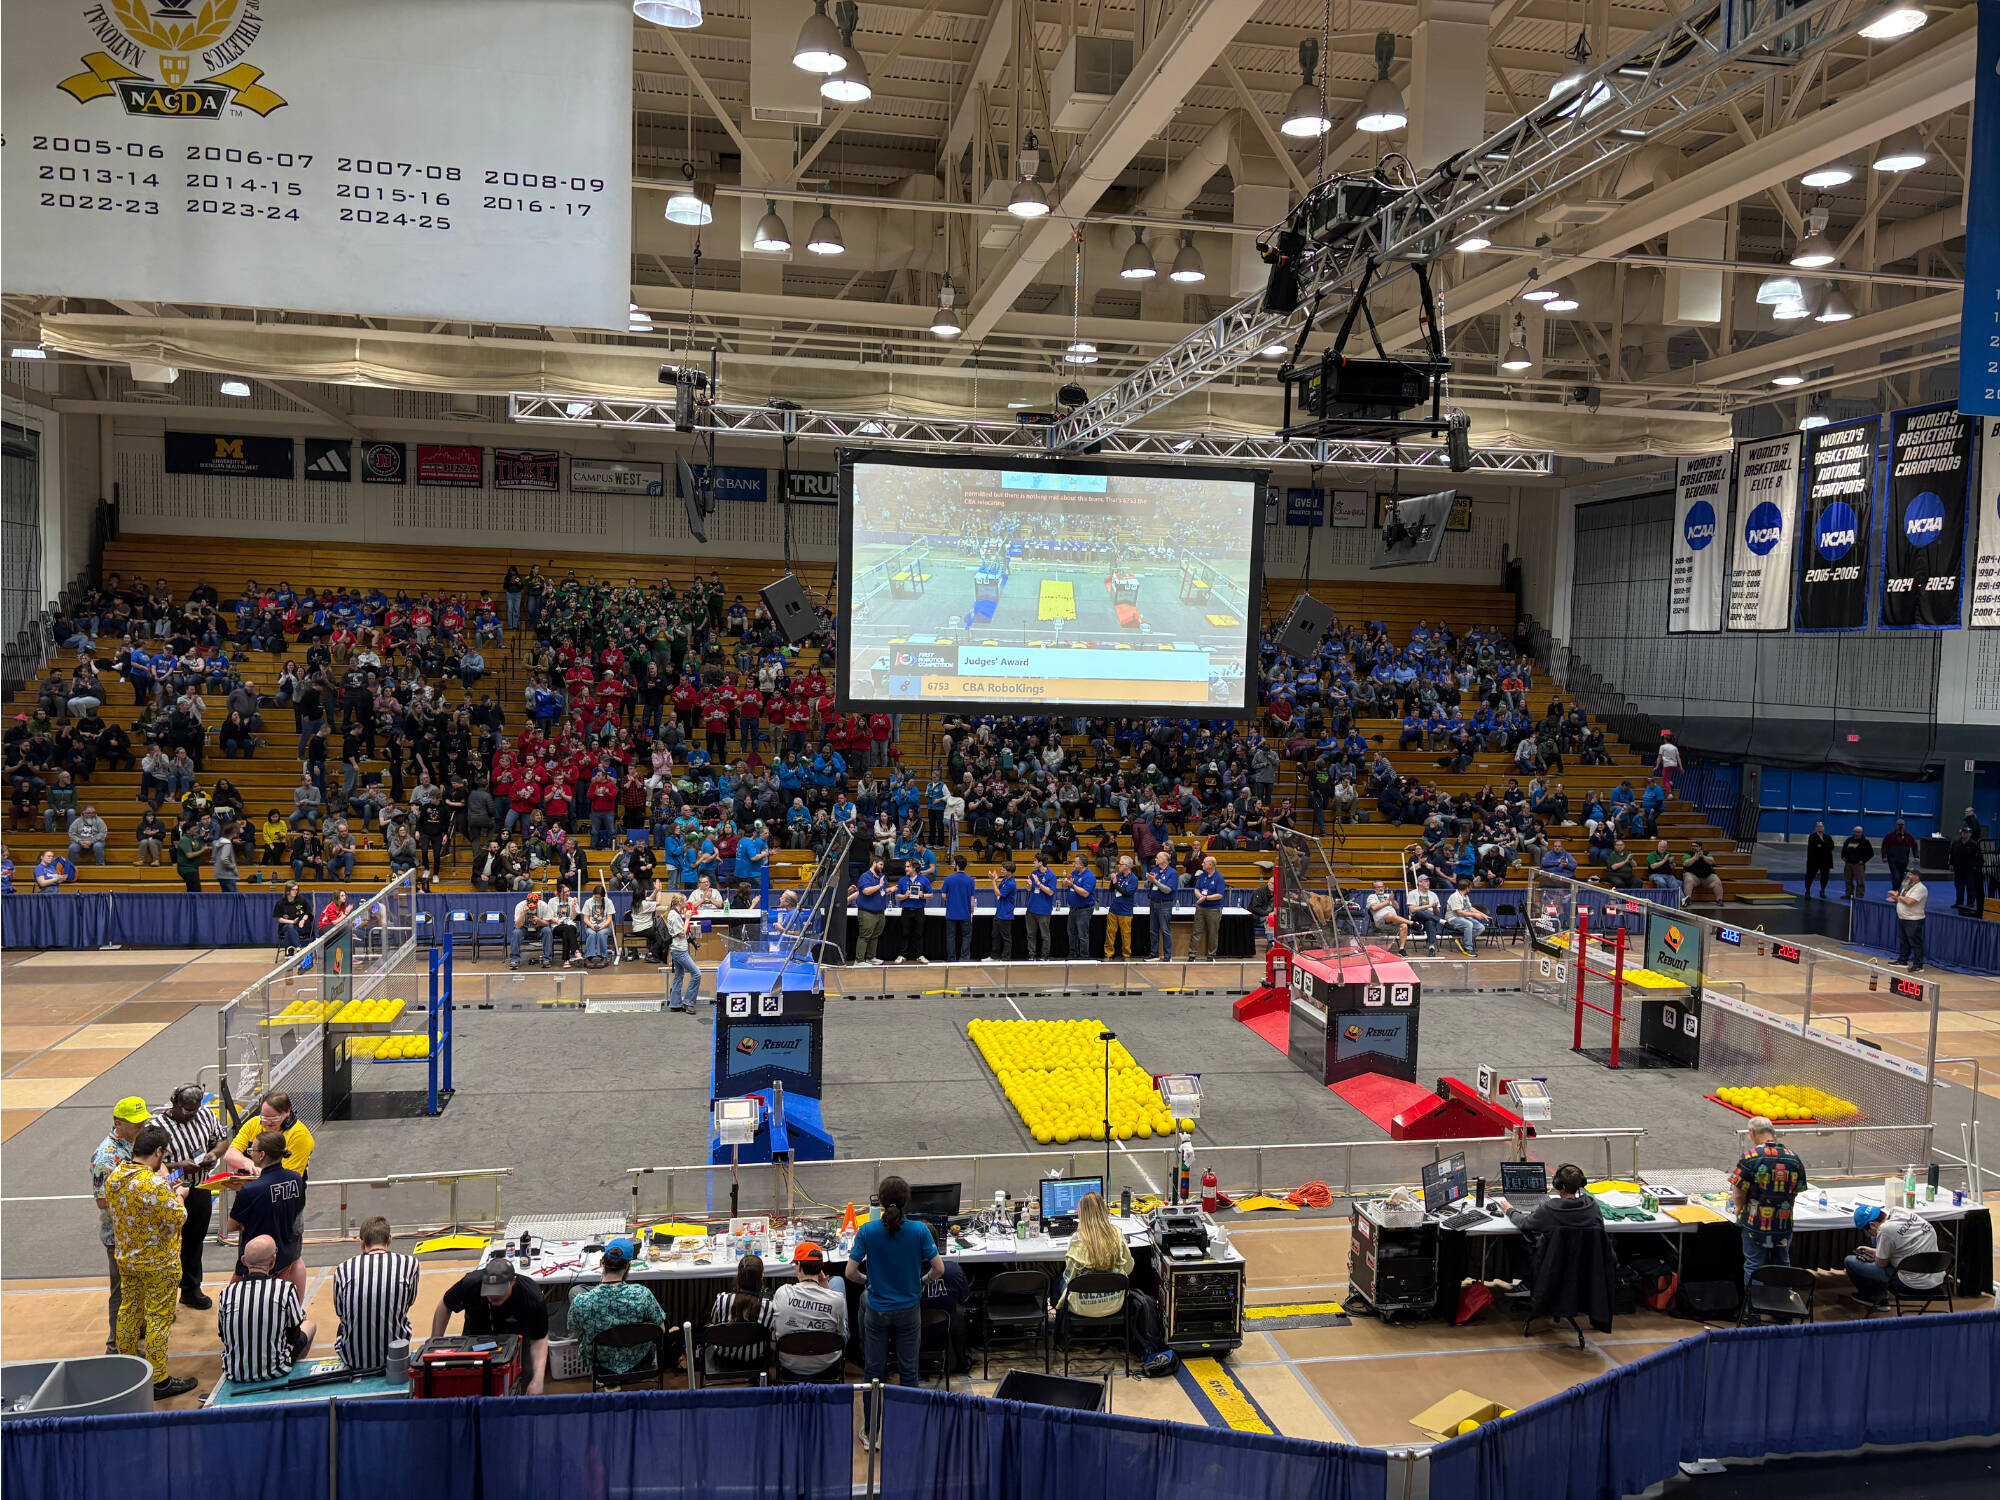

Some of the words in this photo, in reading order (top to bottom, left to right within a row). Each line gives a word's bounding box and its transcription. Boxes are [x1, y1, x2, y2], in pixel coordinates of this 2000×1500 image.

[83, 4, 146, 69] NATIONAL
[202, 11, 264, 72] ATHLETICS
[131, 89, 217, 115] NACDA
[33, 136, 164, 158] 2005-06
[187, 146, 313, 169] 2006-07
[337, 158, 461, 181] 2007-08
[485, 170, 604, 192] 2008-09
[39, 165, 159, 187] 2013-14
[187, 174, 302, 196] 2014-15
[337, 184, 450, 206] 2015-16
[40, 192, 159, 215] 2022-23
[187, 199, 300, 222] 2023-24
[339, 208, 450, 230] 2024-25
[1907, 409, 1959, 431] WOMEN'S
[1819, 427, 1865, 448] WOMEN'S
[1896, 423, 1965, 447] BASKETBALL
[215, 438, 244, 458] M
[1749, 443, 1789, 460] WOMEN'S
[1814, 443, 1869, 465] BASKETBALL
[1902, 441, 1956, 462] NATIONAL
[443, 464, 478, 473] PIZZA
[496, 460, 558, 481] TICKET
[1687, 455, 1722, 472] WOMEN'S
[1744, 458, 1792, 477] BASKETBALL
[1817, 462, 1861, 481] NATIONAL
[1894, 455, 1962, 477] CHAMPIONS
[573, 473, 612, 484] CAMPUS
[614, 472, 641, 486] WEST
[726, 478, 760, 490] BANK
[1751, 477, 1774, 491] ELITE
[1811, 478, 1866, 499] CHAMPIONS
[1688, 524, 1715, 540] NCAA
[1906, 516, 1943, 534] NCAA
[1749, 527, 1780, 544] NCAA
[1820, 529, 1855, 547] NCAA
[1887, 578, 1913, 592] 2024
[1925, 576, 1956, 591] 2025
[964, 657, 998, 667] Judges'
[1001, 658, 1029, 666] Award
[962, 682, 984, 692] CBA
[988, 683, 1045, 695] RoboKings
[1721, 927, 1740, 943] 2026
[1656, 951, 1690, 971] REBUILT
[1778, 943, 1799, 961] 2026
[1898, 978, 1921, 996] 2026
[1365, 1027, 1401, 1038] REBUILT
[762, 1039, 804, 1050] REBUILT
[270, 1180, 300, 1203] FTA
[788, 1297, 833, 1314] VOLUNTEER
